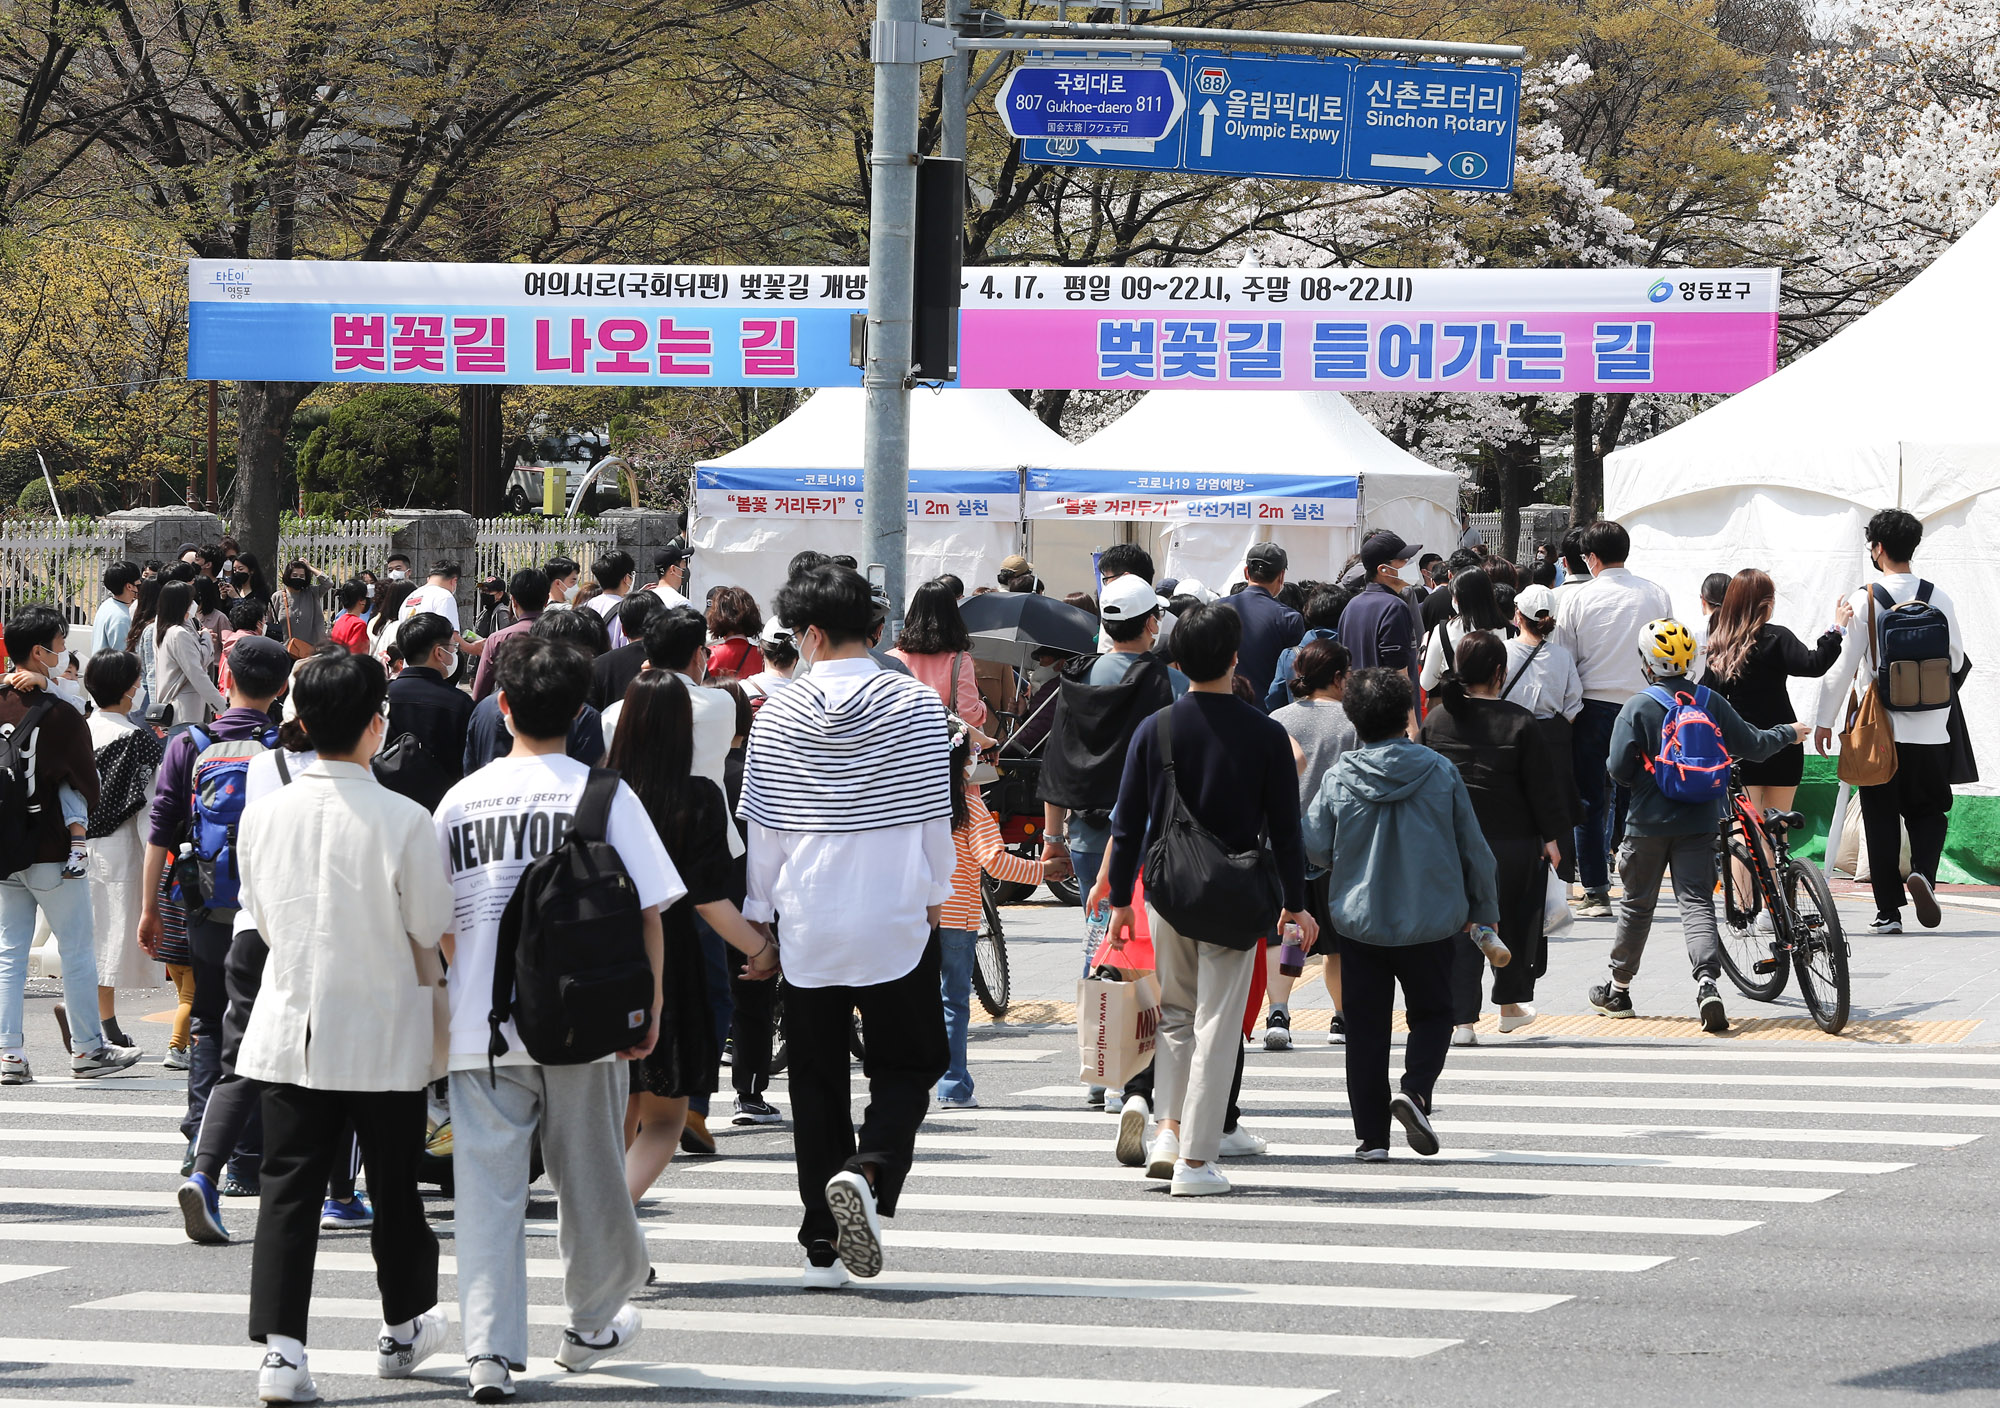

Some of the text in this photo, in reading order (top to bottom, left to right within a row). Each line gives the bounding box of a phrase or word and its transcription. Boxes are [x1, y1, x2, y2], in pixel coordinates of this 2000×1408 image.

[1054, 73, 1127, 95] 국회대로
[1202, 77, 1222, 91] 88
[1015, 94, 1043, 111] 807
[1046, 99, 1133, 114] Gukhoe-daero
[1135, 96, 1162, 112] 811
[1225, 89, 1343, 123] 올림픽대로
[1366, 80, 1503, 115] 신촌로터리
[1047, 122, 1083, 133] 国会大路
[1366, 110, 1507, 136] Sinchon Rotary
[1224, 122, 1340, 145] Olympic Expwy
[1053, 138, 1073, 151] 120
[1461, 157, 1475, 175] 6
[227, 286, 251, 299] 영등포
[524, 271, 1413, 303] 여의서로(국회뒤편) 벚꽃길 개방 4. 17. 평일 09~22시, 주말 08~22시)
[1678, 281, 1752, 300] 영등포구
[332, 313, 799, 376] 벚꽃길 나오는 길
[1097, 319, 1655, 383] 벚꽃길 들어가는 길
[1195, 479, 1254, 492] 감염예방-
[774, 497, 846, 515] 거리두기”
[925, 500, 950, 515] 2m
[955, 501, 989, 517] 실천
[1104, 500, 1179, 517] 거리두기”
[1186, 501, 1252, 519] 안전거리
[1258, 504, 1284, 519] 2m
[1291, 503, 1325, 520] 실천
[464, 793, 572, 812] STATUE OF LIBERTY
[448, 811, 575, 875] NEWYOR
[1097, 992, 1107, 1077] www.muji.com
